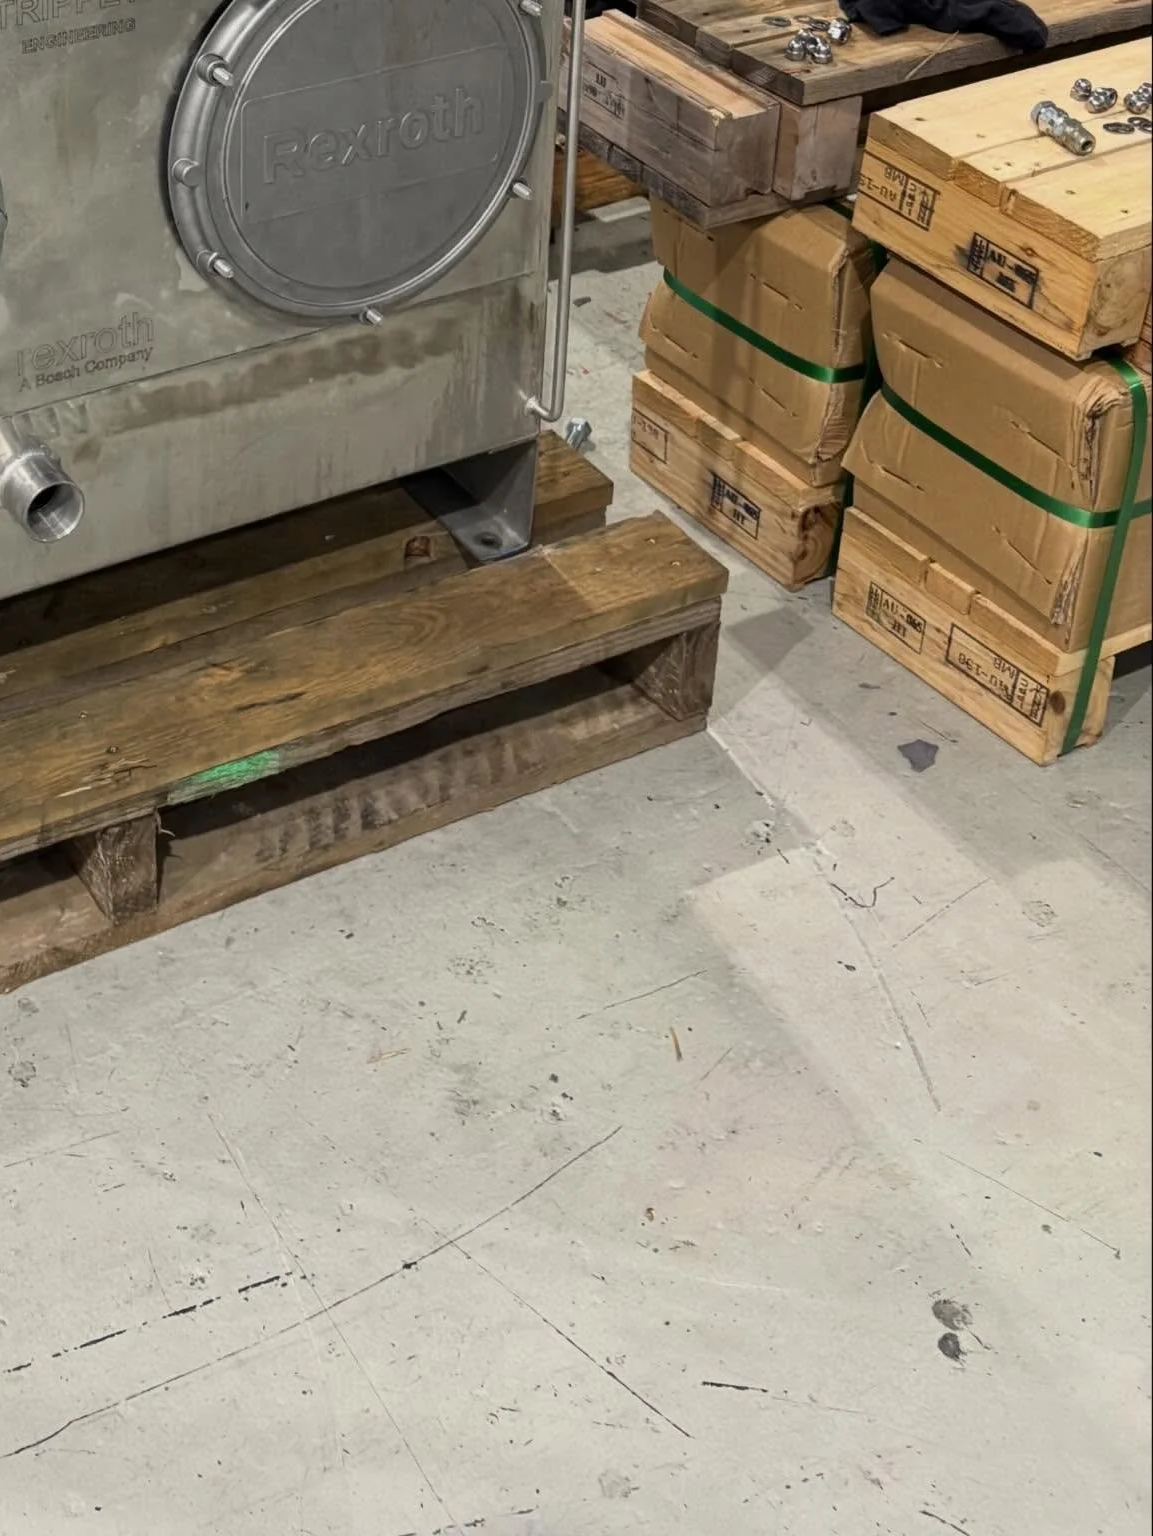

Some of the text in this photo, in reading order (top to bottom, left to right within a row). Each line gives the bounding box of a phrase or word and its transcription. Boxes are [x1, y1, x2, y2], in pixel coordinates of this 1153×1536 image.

[21, 17, 137, 54] ENGINEERING
[262, 87, 485, 185] Rexroth
[16, 312, 154, 377] rexroth
[18, 346, 154, 393] A Bosch Company
